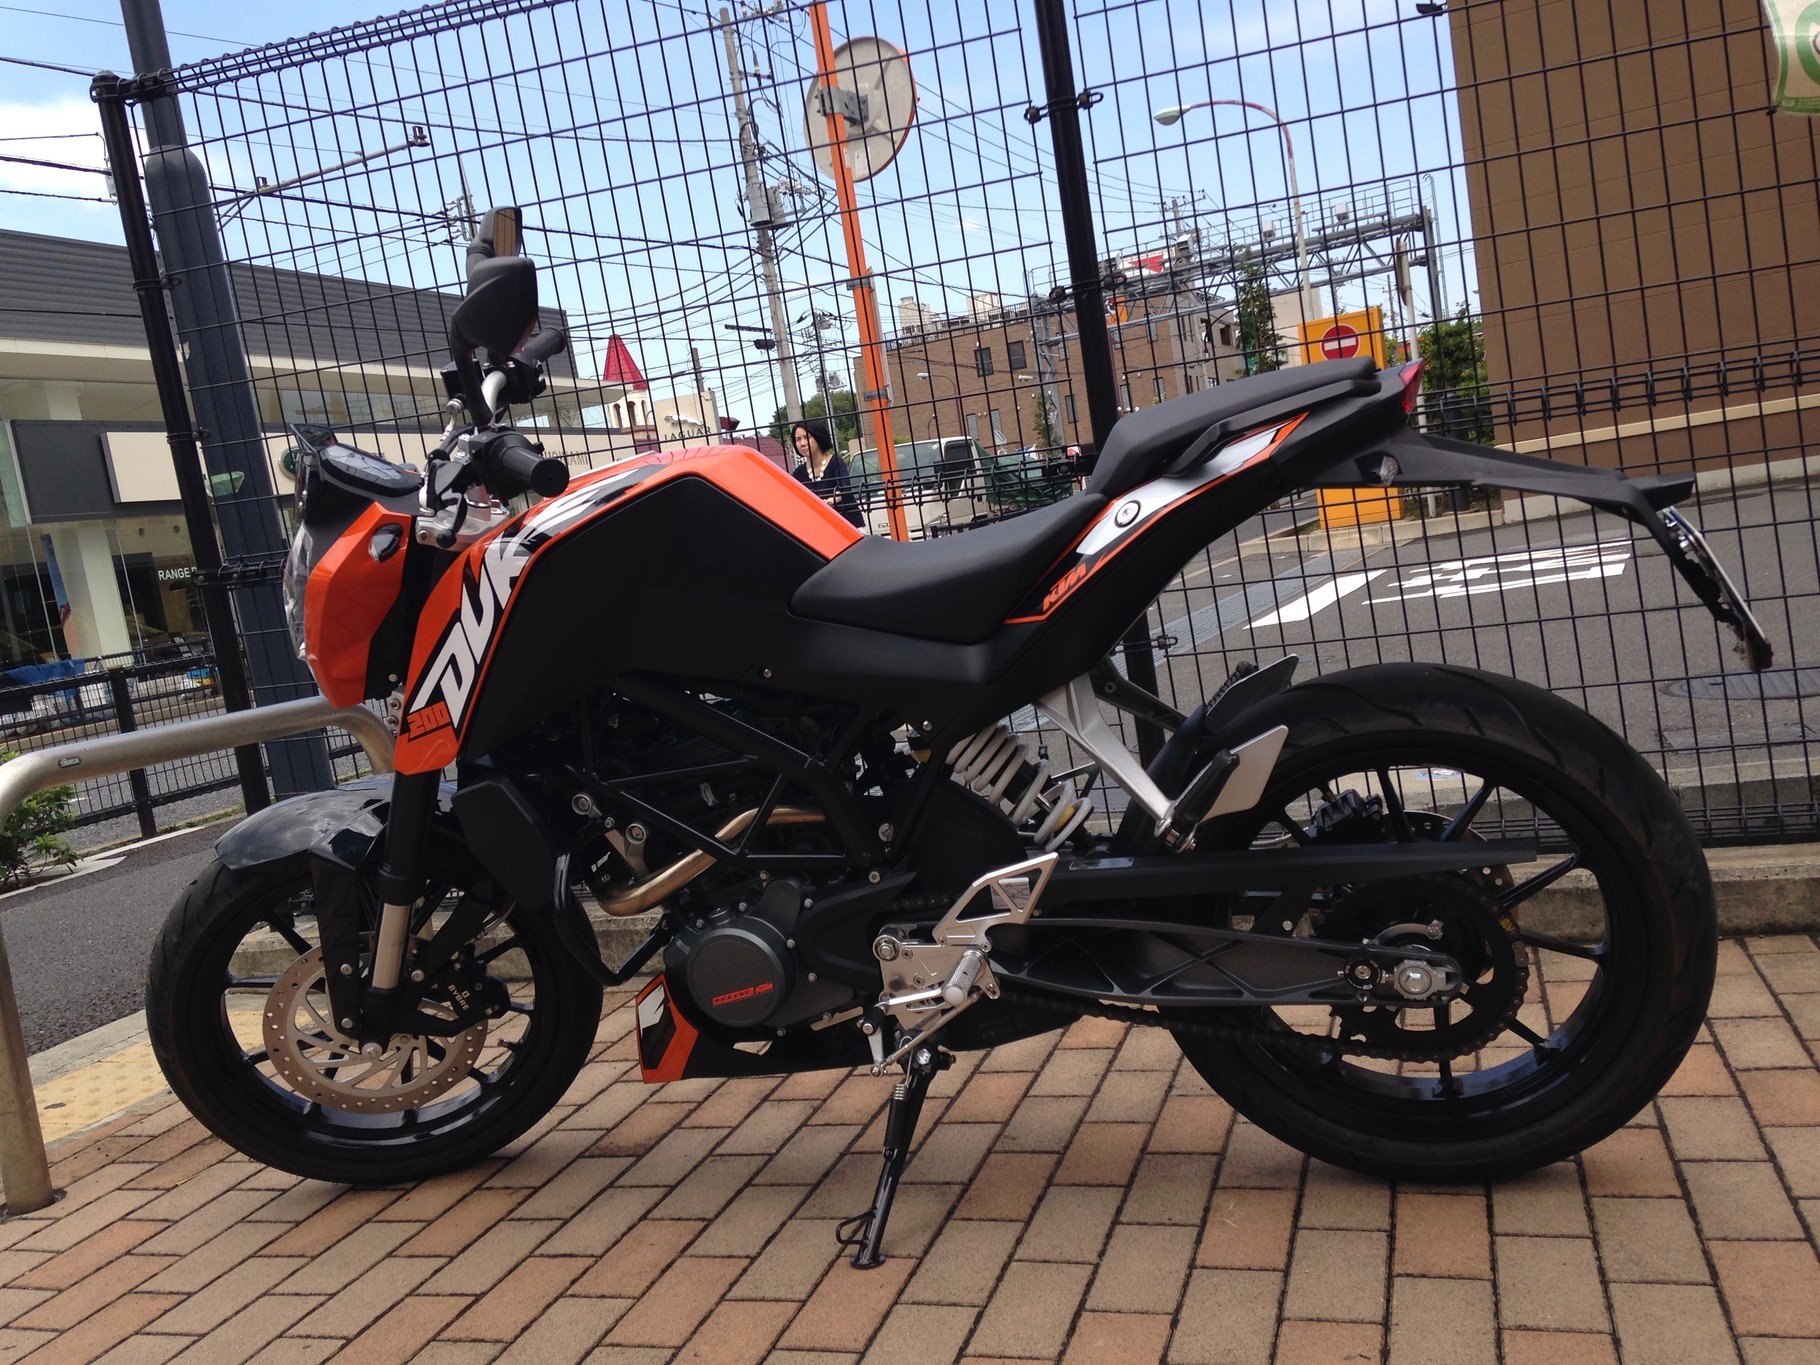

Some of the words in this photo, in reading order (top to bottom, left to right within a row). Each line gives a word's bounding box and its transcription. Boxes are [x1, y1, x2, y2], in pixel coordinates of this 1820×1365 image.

[664, 426, 711, 441] JAGUAR
[157, 567, 191, 581] RANGE
[1043, 562, 1087, 612] KTM
[406, 700, 452, 740] 200
